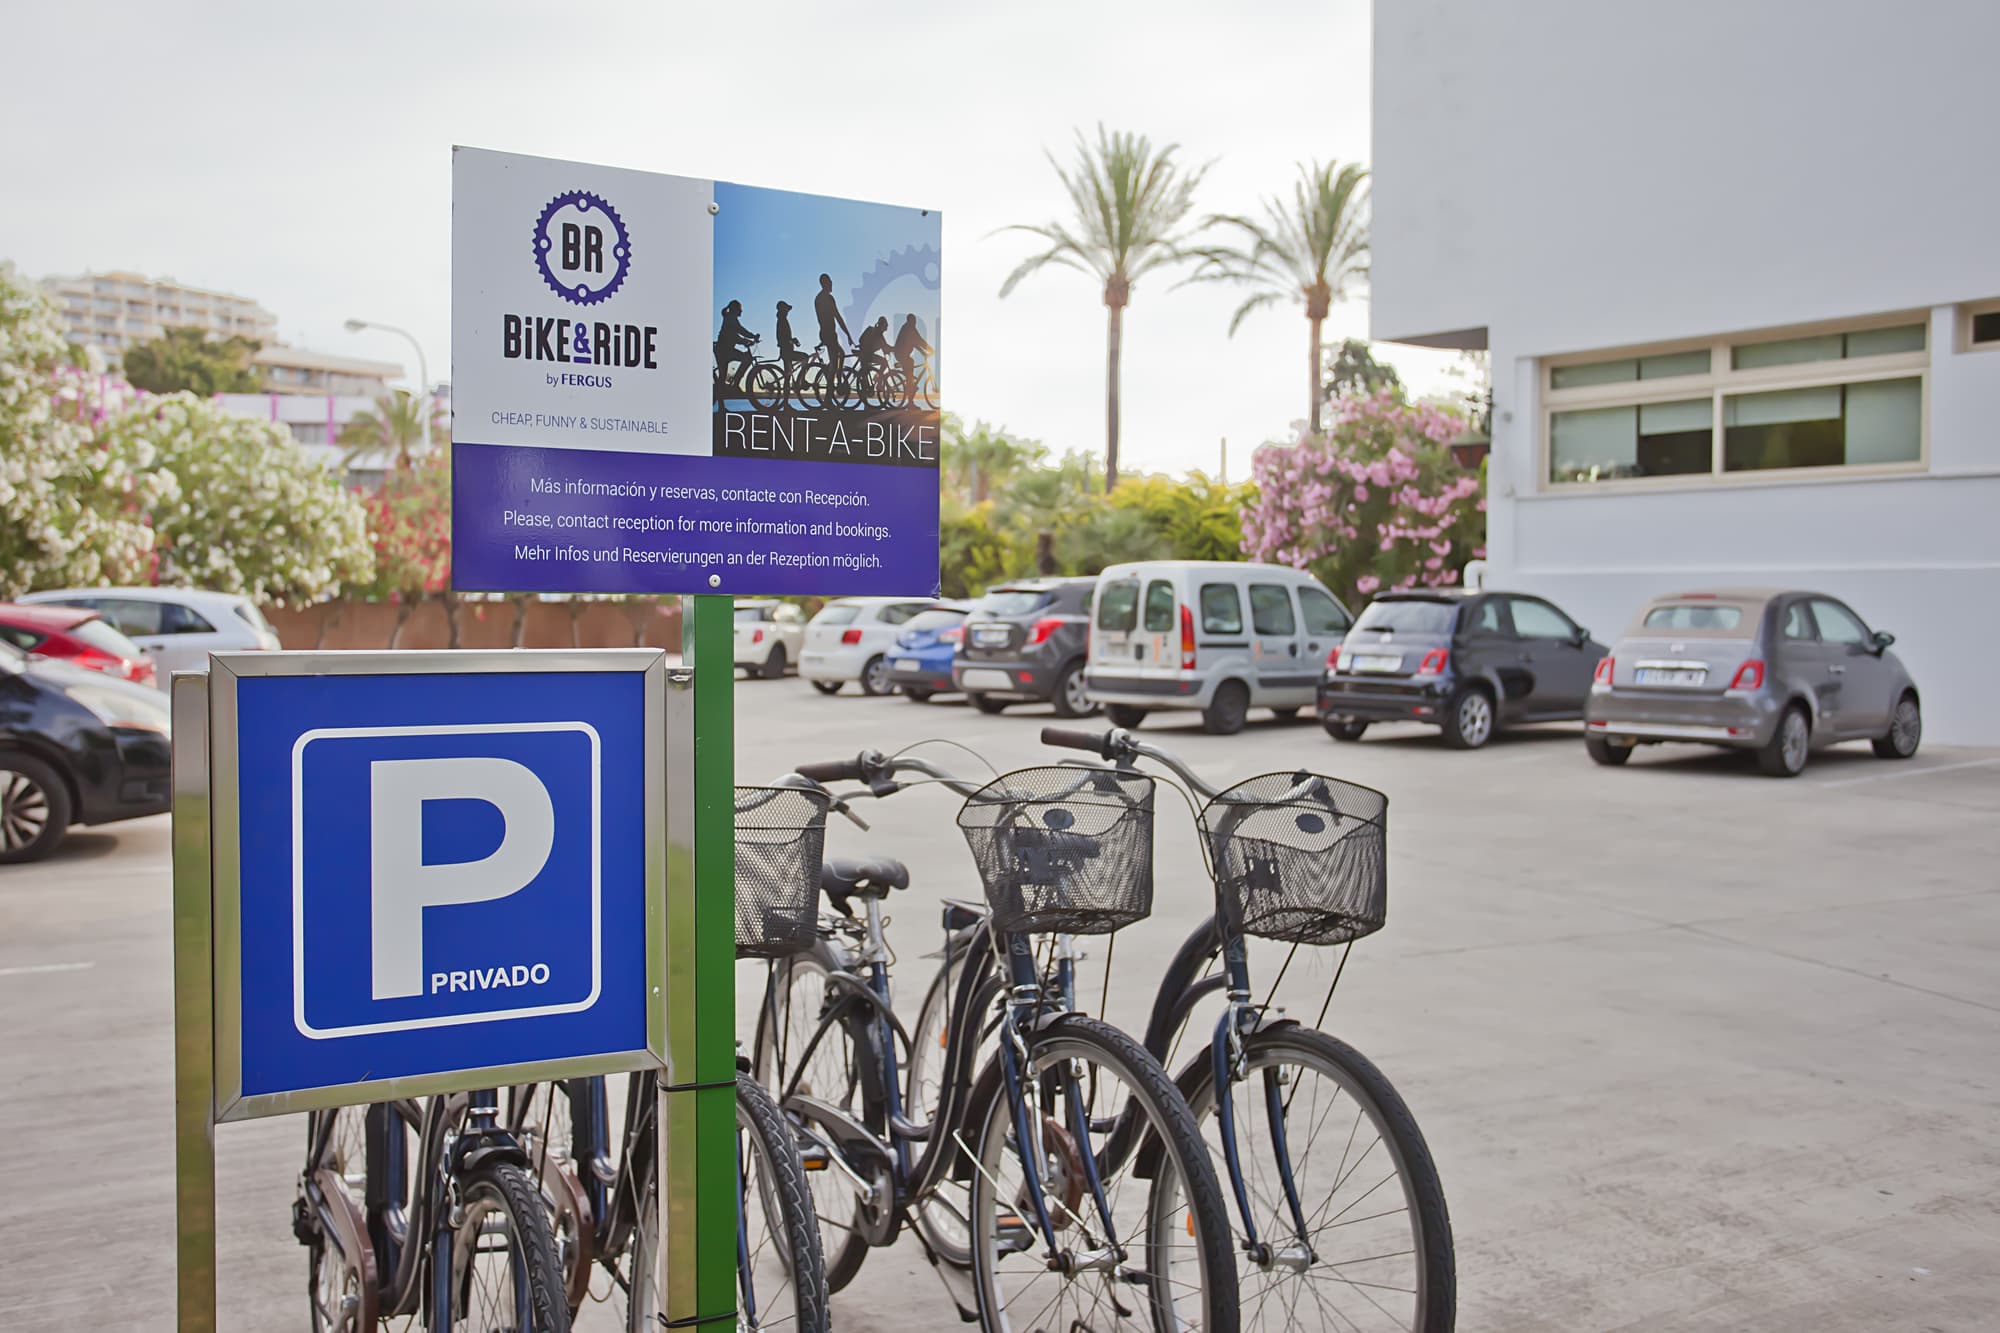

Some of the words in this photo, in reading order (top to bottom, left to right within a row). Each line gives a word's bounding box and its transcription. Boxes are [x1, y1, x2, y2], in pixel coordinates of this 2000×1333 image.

[561, 222, 603, 274] BR
[546, 373, 559, 388] by
[561, 373, 612, 388] FERGUS
[491, 411, 533, 428] CHEAP,
[536, 414, 577, 428] FUNNY
[579, 417, 588, 429] &
[590, 418, 668, 434] SUSTAINABLE
[725, 413, 935, 460] RENT-A-BIKE
[530, 477, 561, 494] Más
[565, 478, 646, 497] información
[650, 486, 657, 501] y
[660, 487, 718, 501] reservas,
[721, 488, 776, 503] contacte
[779, 491, 802, 504] con
[805, 490, 870, 508] Recepción.
[504, 510, 554, 528] Please,
[557, 514, 609, 529] contact
[613, 515, 674, 533] reception
[678, 515, 696, 531] for
[699, 519, 733, 533] more
[736, 518, 807, 535] information
[810, 522, 833, 536] and
[836, 522, 892, 541] bookings.
[514, 544, 552, 560] Mehr
[555, 545, 589, 561] Infos
[593, 547, 619, 561] und
[623, 547, 724, 567] Reservierungen
[727, 553, 743, 565] an
[746, 550, 766, 565] der
[770, 551, 830, 569] Rezeption
[833, 553, 883, 571] möglich.
[370, 757, 555, 1000] P
[431, 963, 550, 995] PRIVADO
